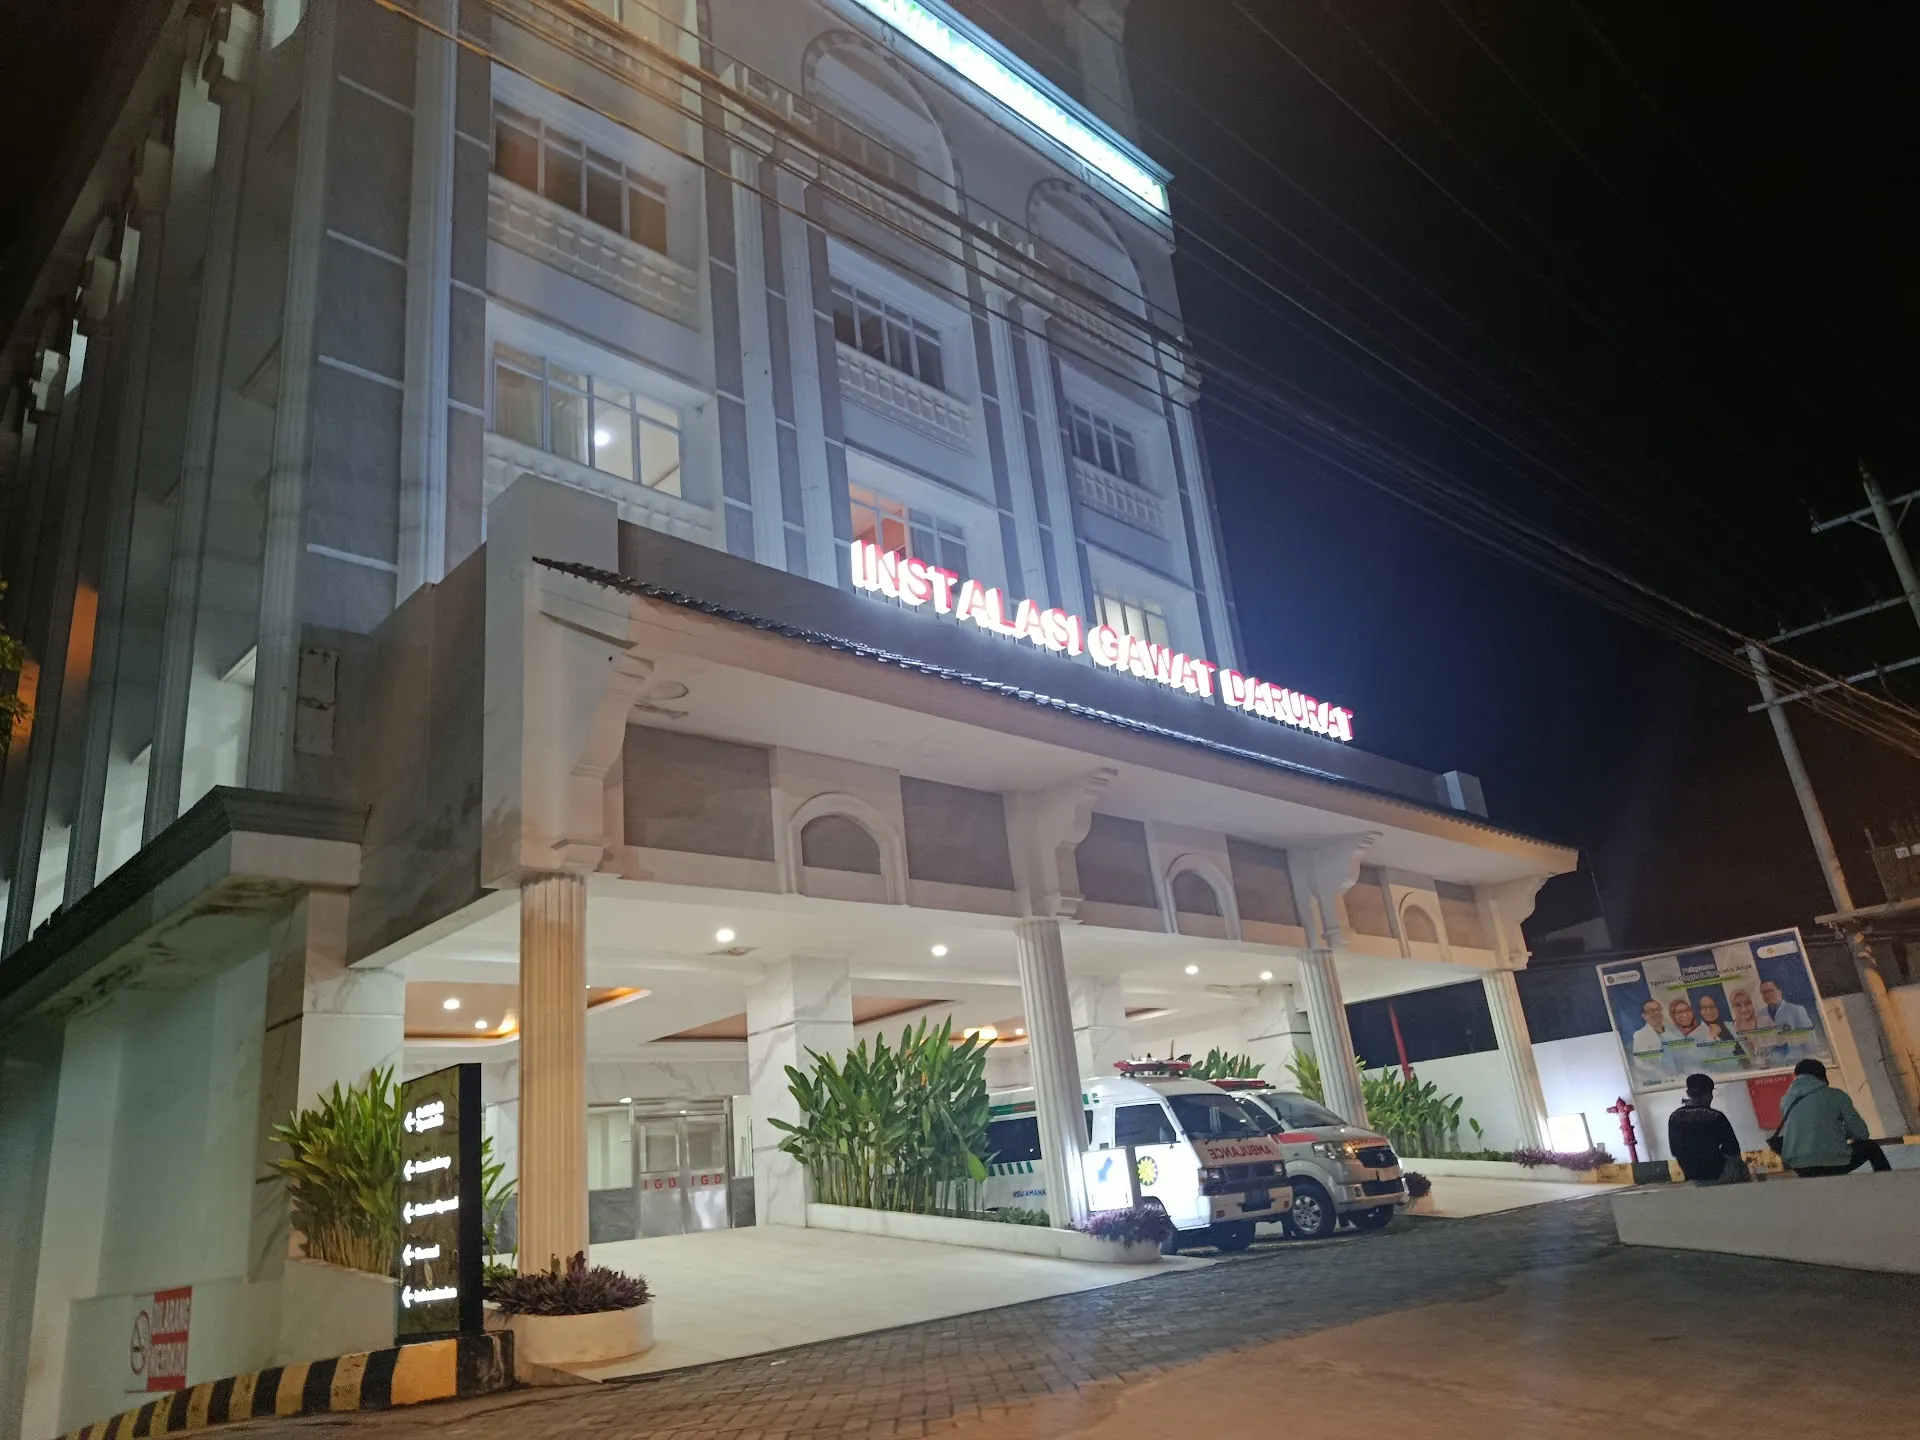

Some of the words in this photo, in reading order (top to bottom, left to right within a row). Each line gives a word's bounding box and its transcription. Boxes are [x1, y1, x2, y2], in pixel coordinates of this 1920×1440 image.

[851, 539, 1083, 657] INSTALASI
[1088, 624, 1217, 698] GAWAT
[1220, 668, 1354, 742] DARURAT
[644, 1177, 676, 1190] IGD
[692, 1173, 722, 1186] IGD
